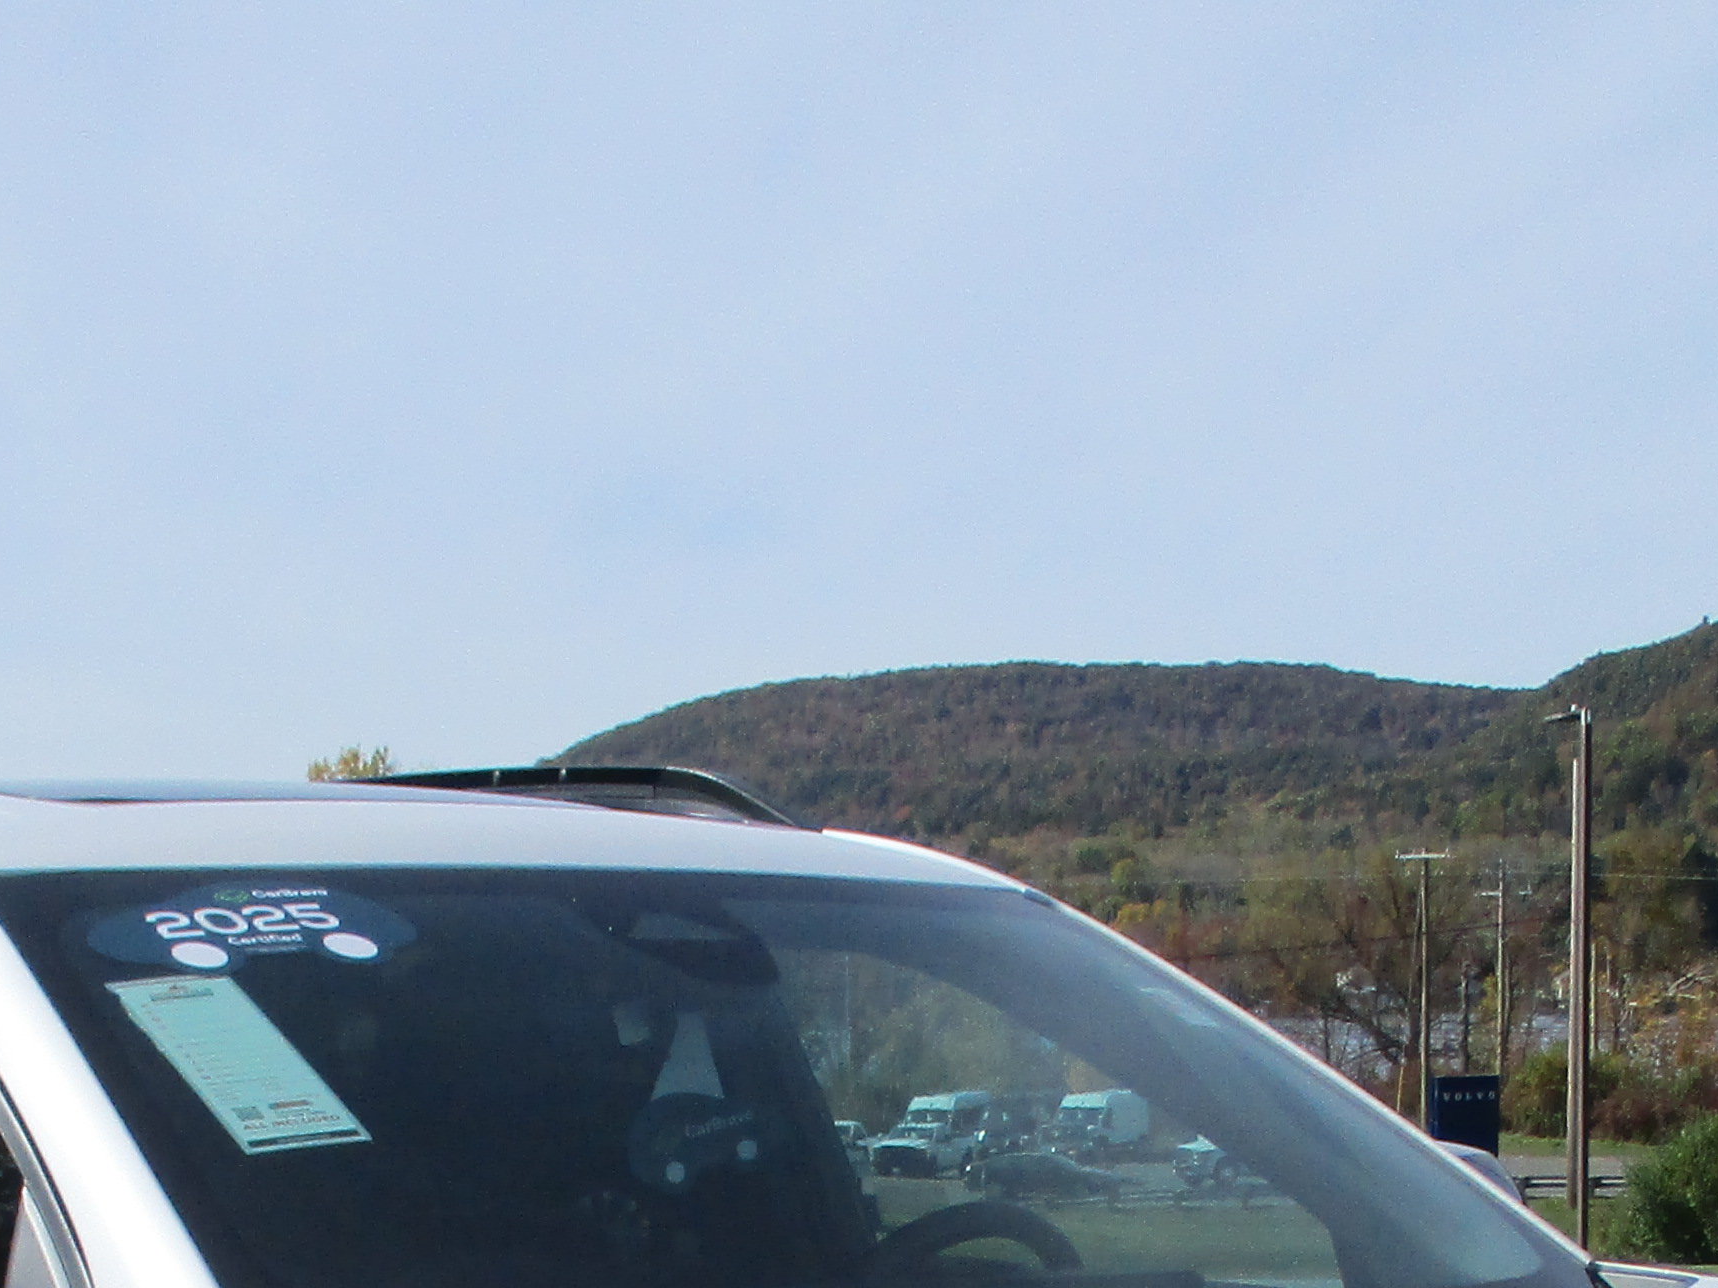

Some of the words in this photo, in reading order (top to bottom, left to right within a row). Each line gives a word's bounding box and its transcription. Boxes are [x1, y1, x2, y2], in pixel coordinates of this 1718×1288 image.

[144, 902, 341, 940] 2025
[226, 932, 304, 947] Certified
[1443, 1090, 1496, 1102] VOLVO
